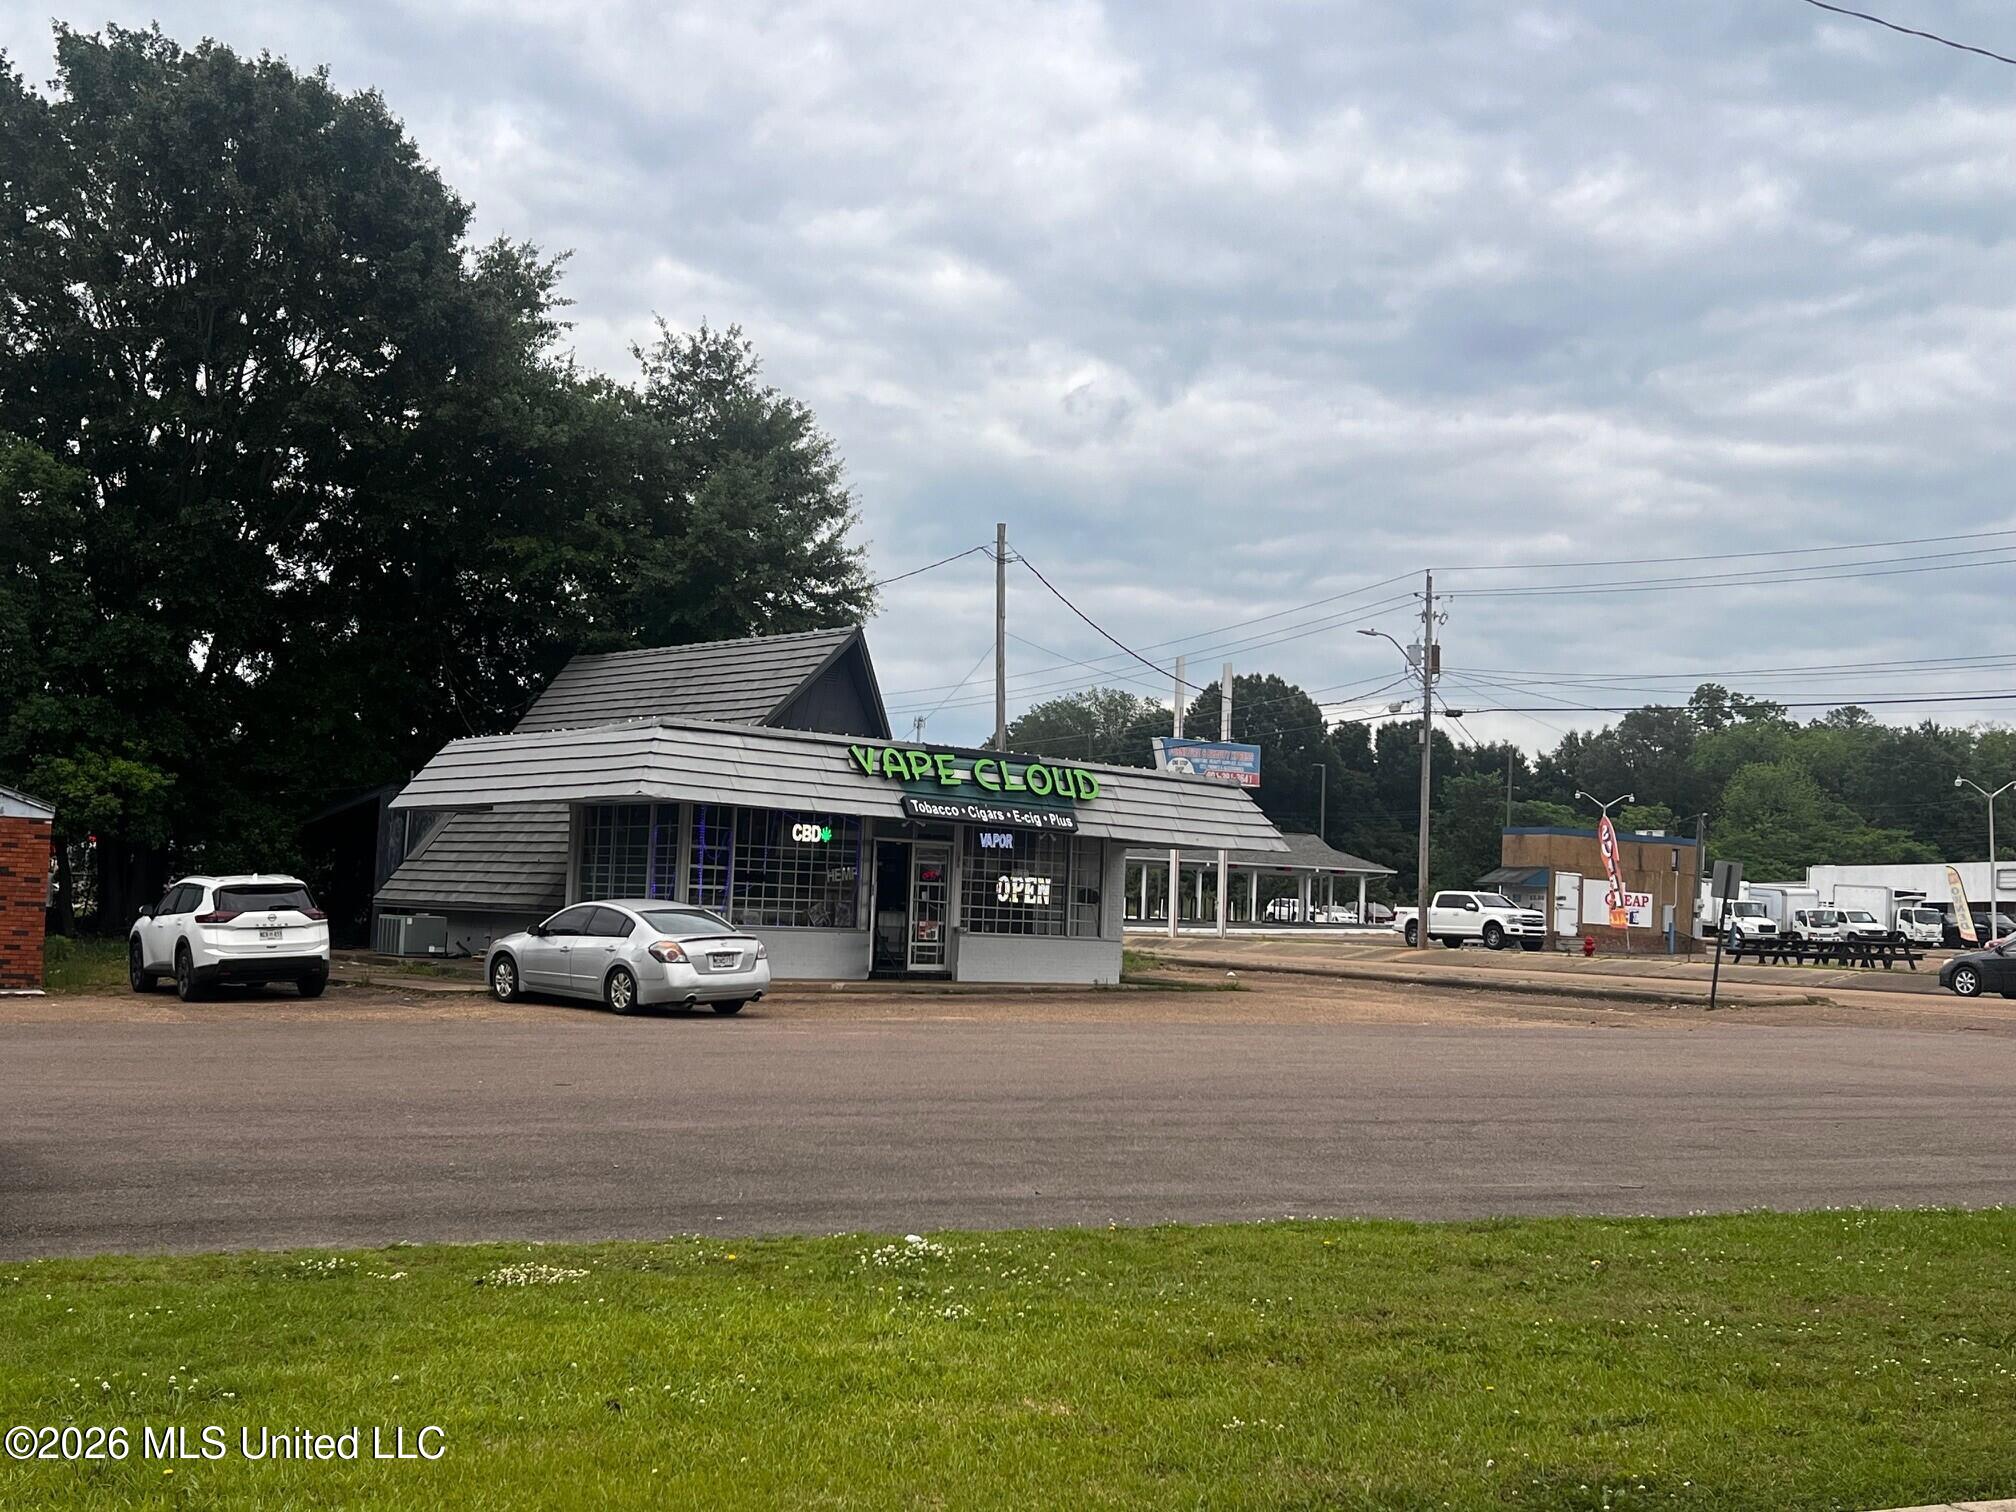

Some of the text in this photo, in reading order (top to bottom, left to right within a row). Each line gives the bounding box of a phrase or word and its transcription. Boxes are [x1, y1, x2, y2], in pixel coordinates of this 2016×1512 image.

[850, 745, 1100, 800] VAPE CLOUD
[910, 800, 1073, 828] Tobacco Cigars E-cig Plus
[792, 823, 821, 843] CBD
[979, 833, 1014, 849] VAPOR
[827, 867, 858, 882] HEMP
[996, 875, 1052, 905] OPEN
[1605, 893, 1650, 909] CEAP
